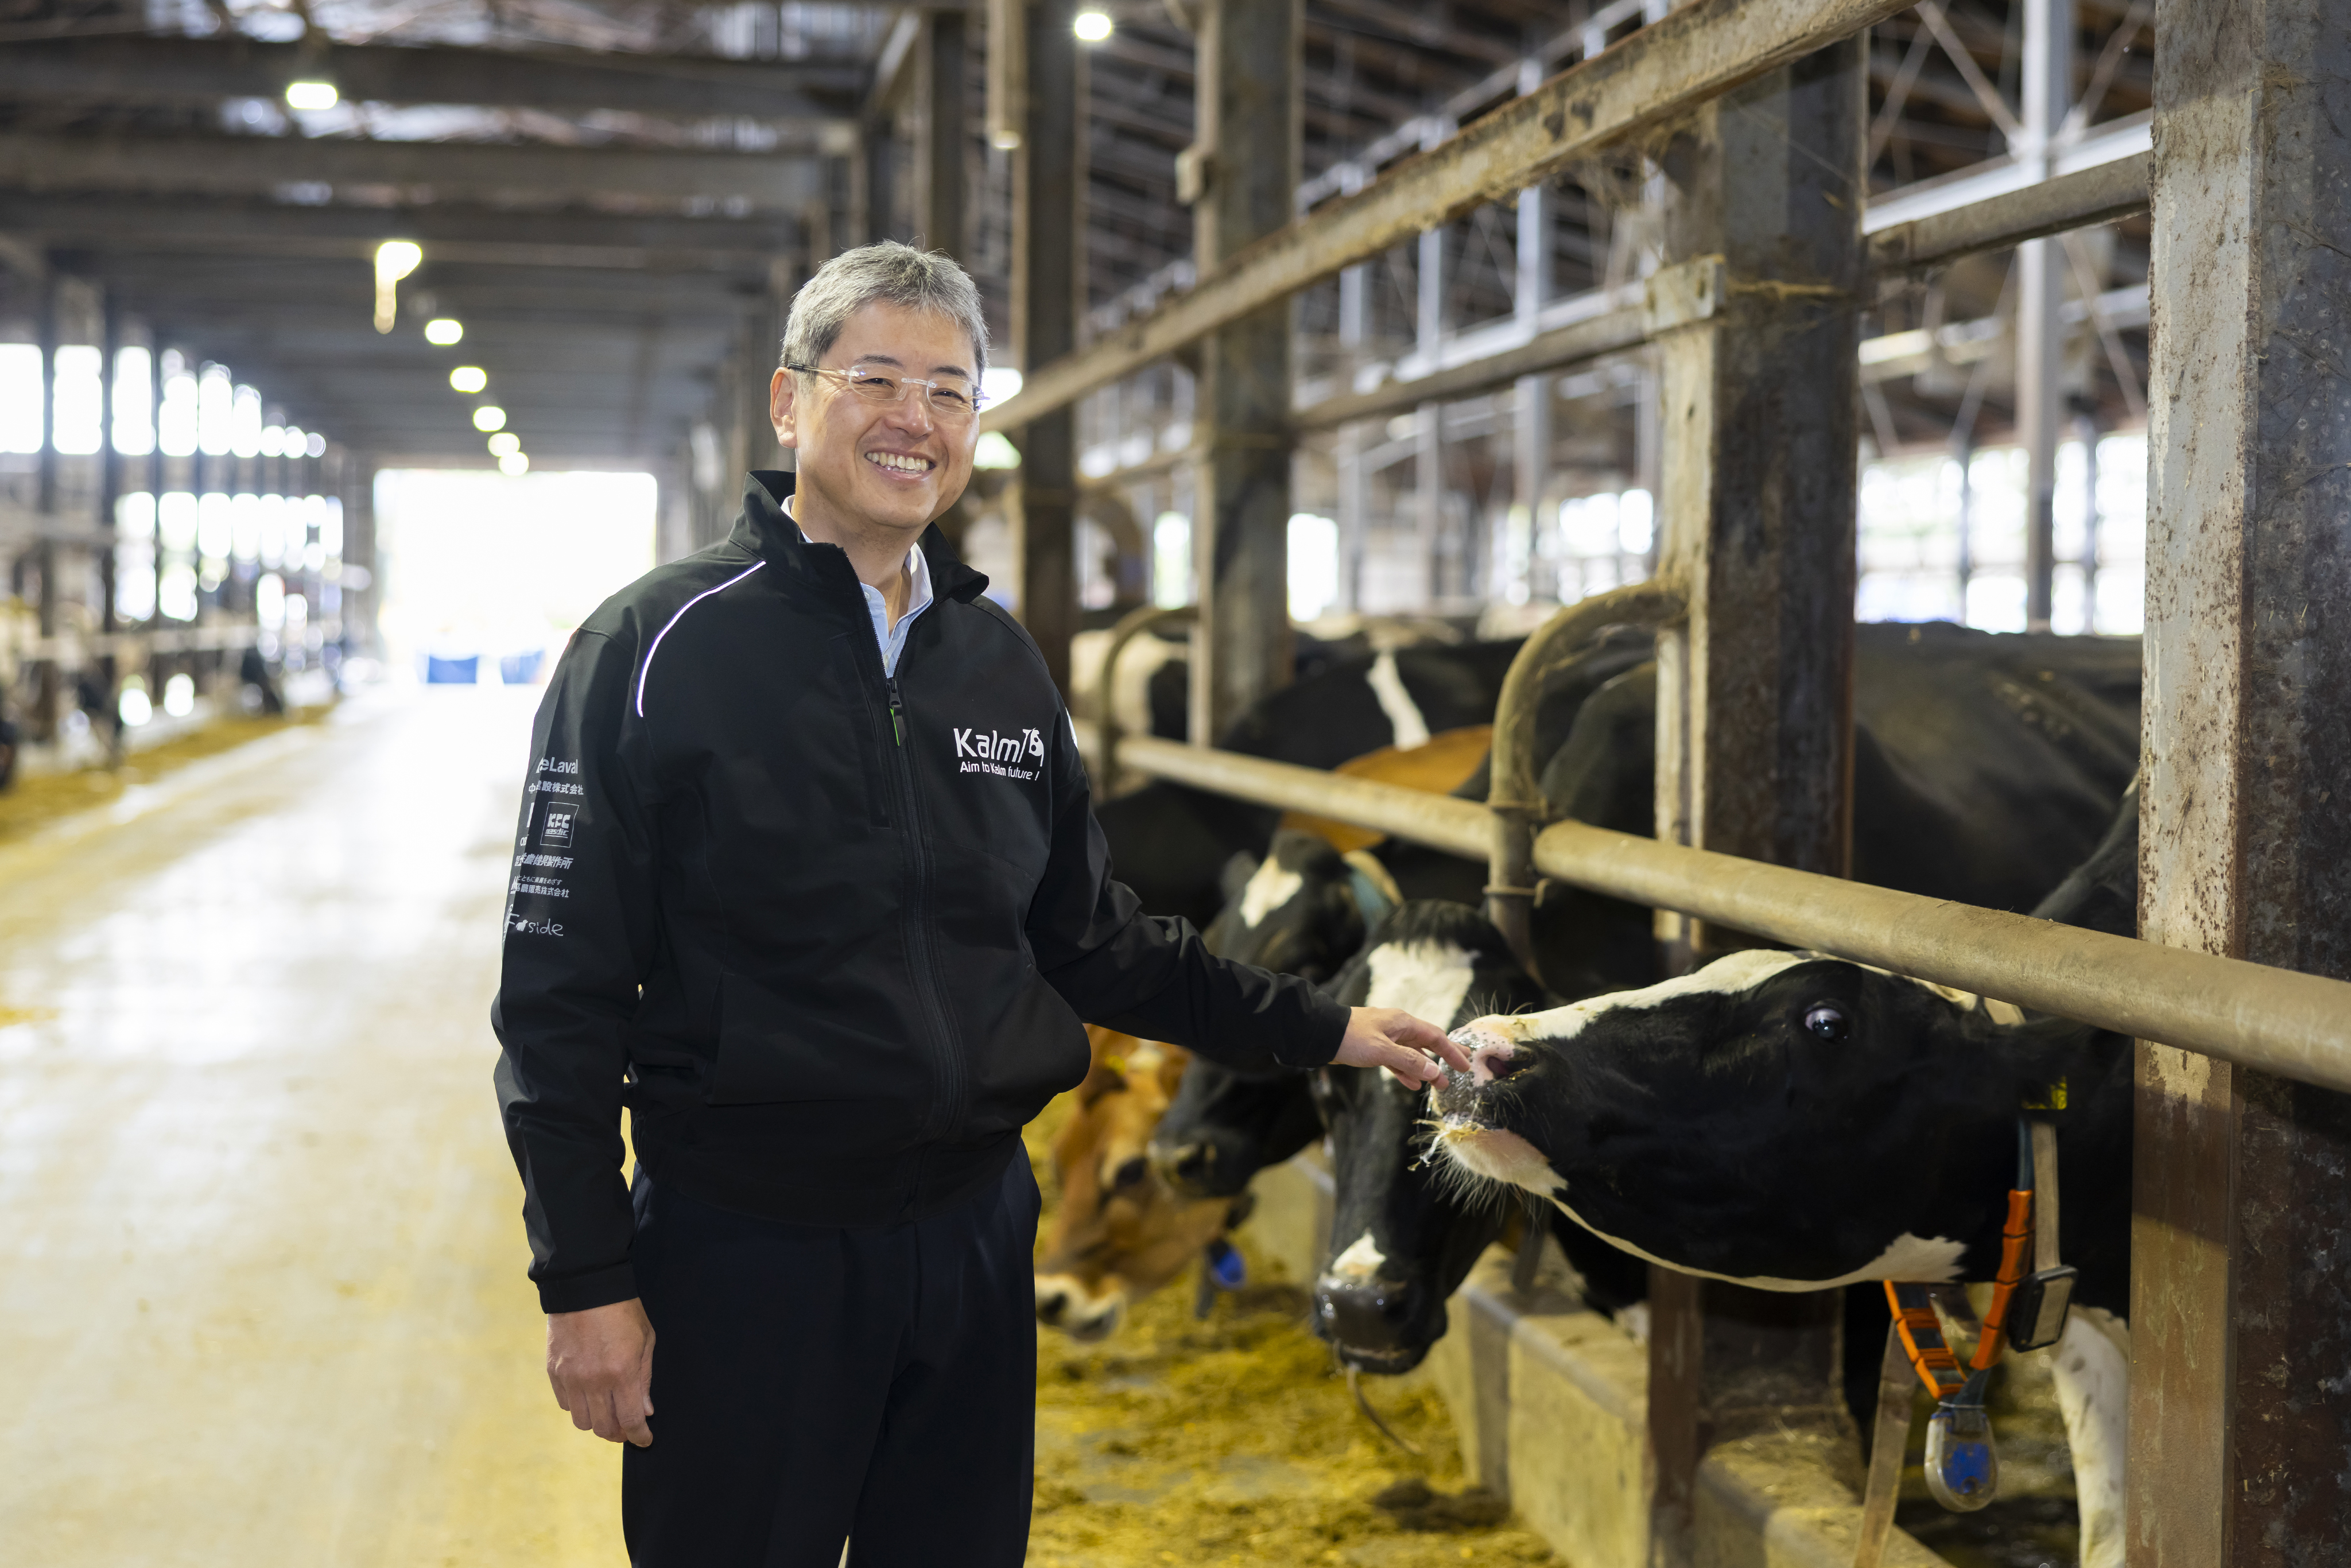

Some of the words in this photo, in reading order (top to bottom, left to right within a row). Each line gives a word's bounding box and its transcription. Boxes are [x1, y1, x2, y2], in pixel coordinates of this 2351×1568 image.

[960, 761, 980, 773] Aim
[981, 761, 990, 773] to
[990, 762, 1006, 777] Kalm
[1008, 766, 1033, 780] future
[547, 813, 571, 829] KFC
